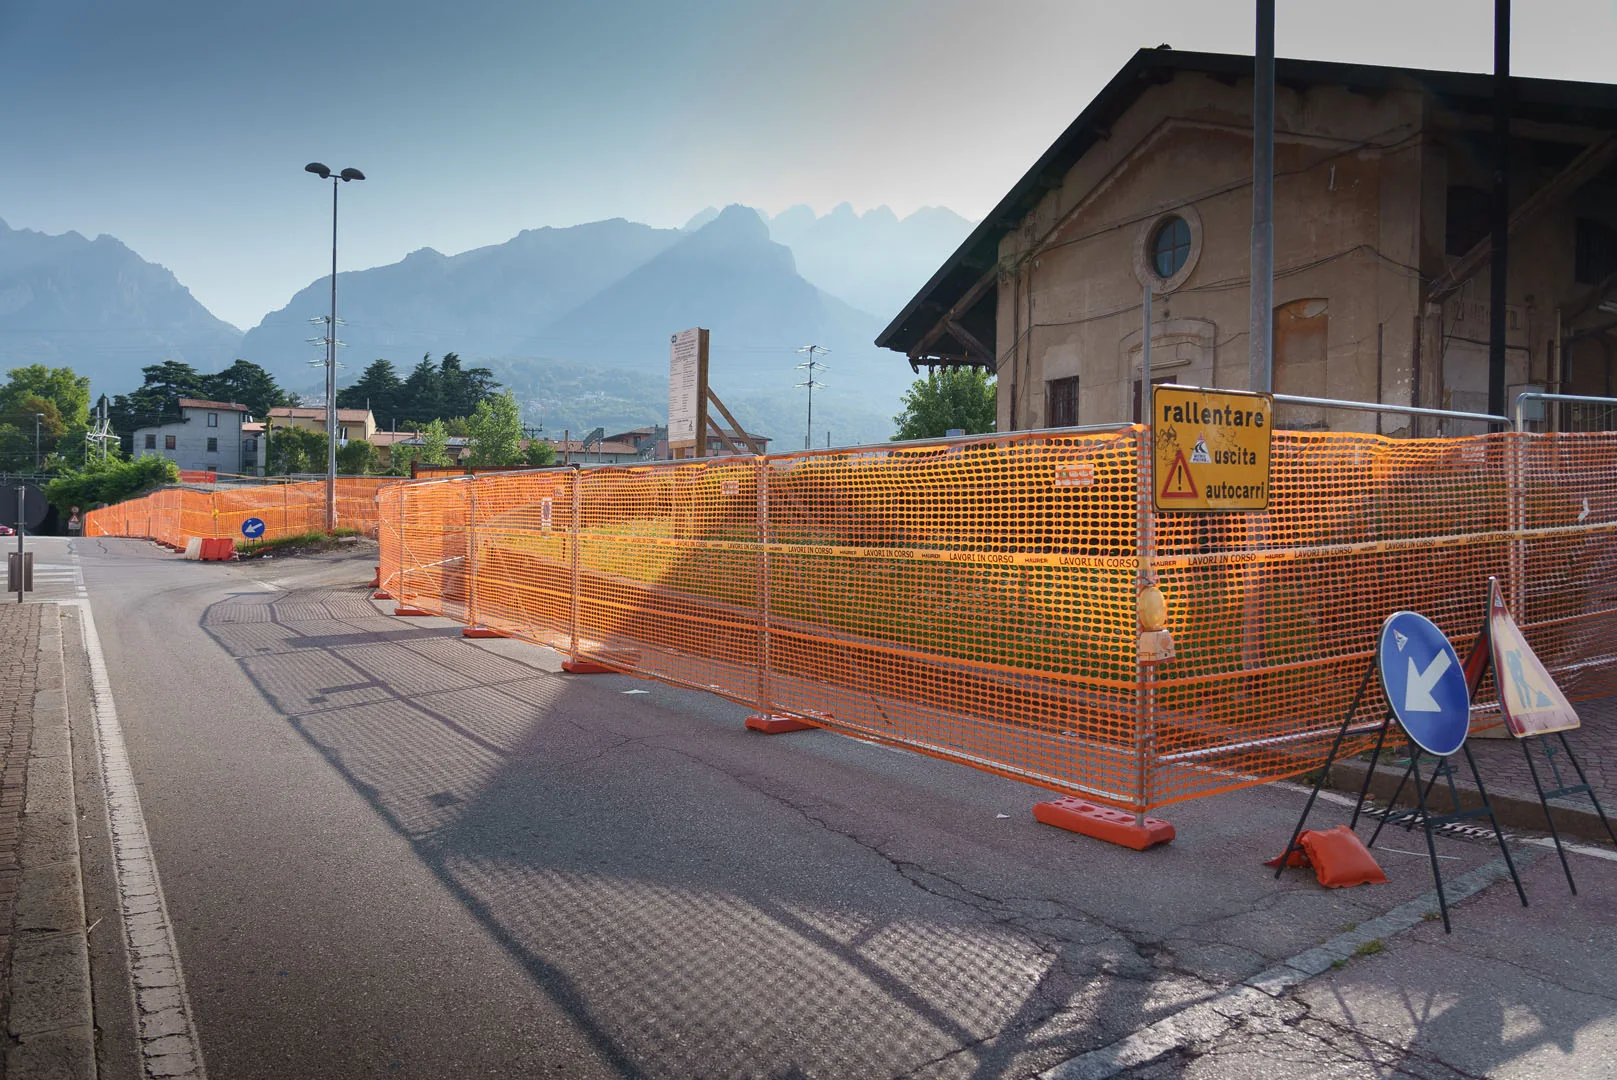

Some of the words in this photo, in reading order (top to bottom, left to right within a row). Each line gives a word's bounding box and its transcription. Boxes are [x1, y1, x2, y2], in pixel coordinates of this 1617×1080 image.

[1164, 401, 1264, 428] rallentare
[1215, 447, 1256, 465] uscita
[1206, 481, 1264, 499] autocarri
[1384, 541, 1407, 551] LAVORI
[1408, 541, 1415, 549] IN
[1416, 539, 1435, 548] CORSO
[863, 549, 885, 557] LAVORI
[894, 550, 914, 558] CORSO
[949, 553, 976, 562] LAVORI
[978, 554, 986, 562] IN
[988, 554, 1014, 563] CORSO
[1294, 548, 1319, 558] LAVORI
[1320, 548, 1329, 557] IN
[1331, 546, 1353, 556] CORSO
[1059, 556, 1092, 566] LAVORI
[1094, 558, 1104, 567] IN
[1106, 558, 1139, 568] CORSO
[1150, 560, 1177, 568] MAURER
[1188, 555, 1218, 566] LAVORI
[1219, 555, 1228, 564] IN
[1230, 553, 1256, 563] CORSO
